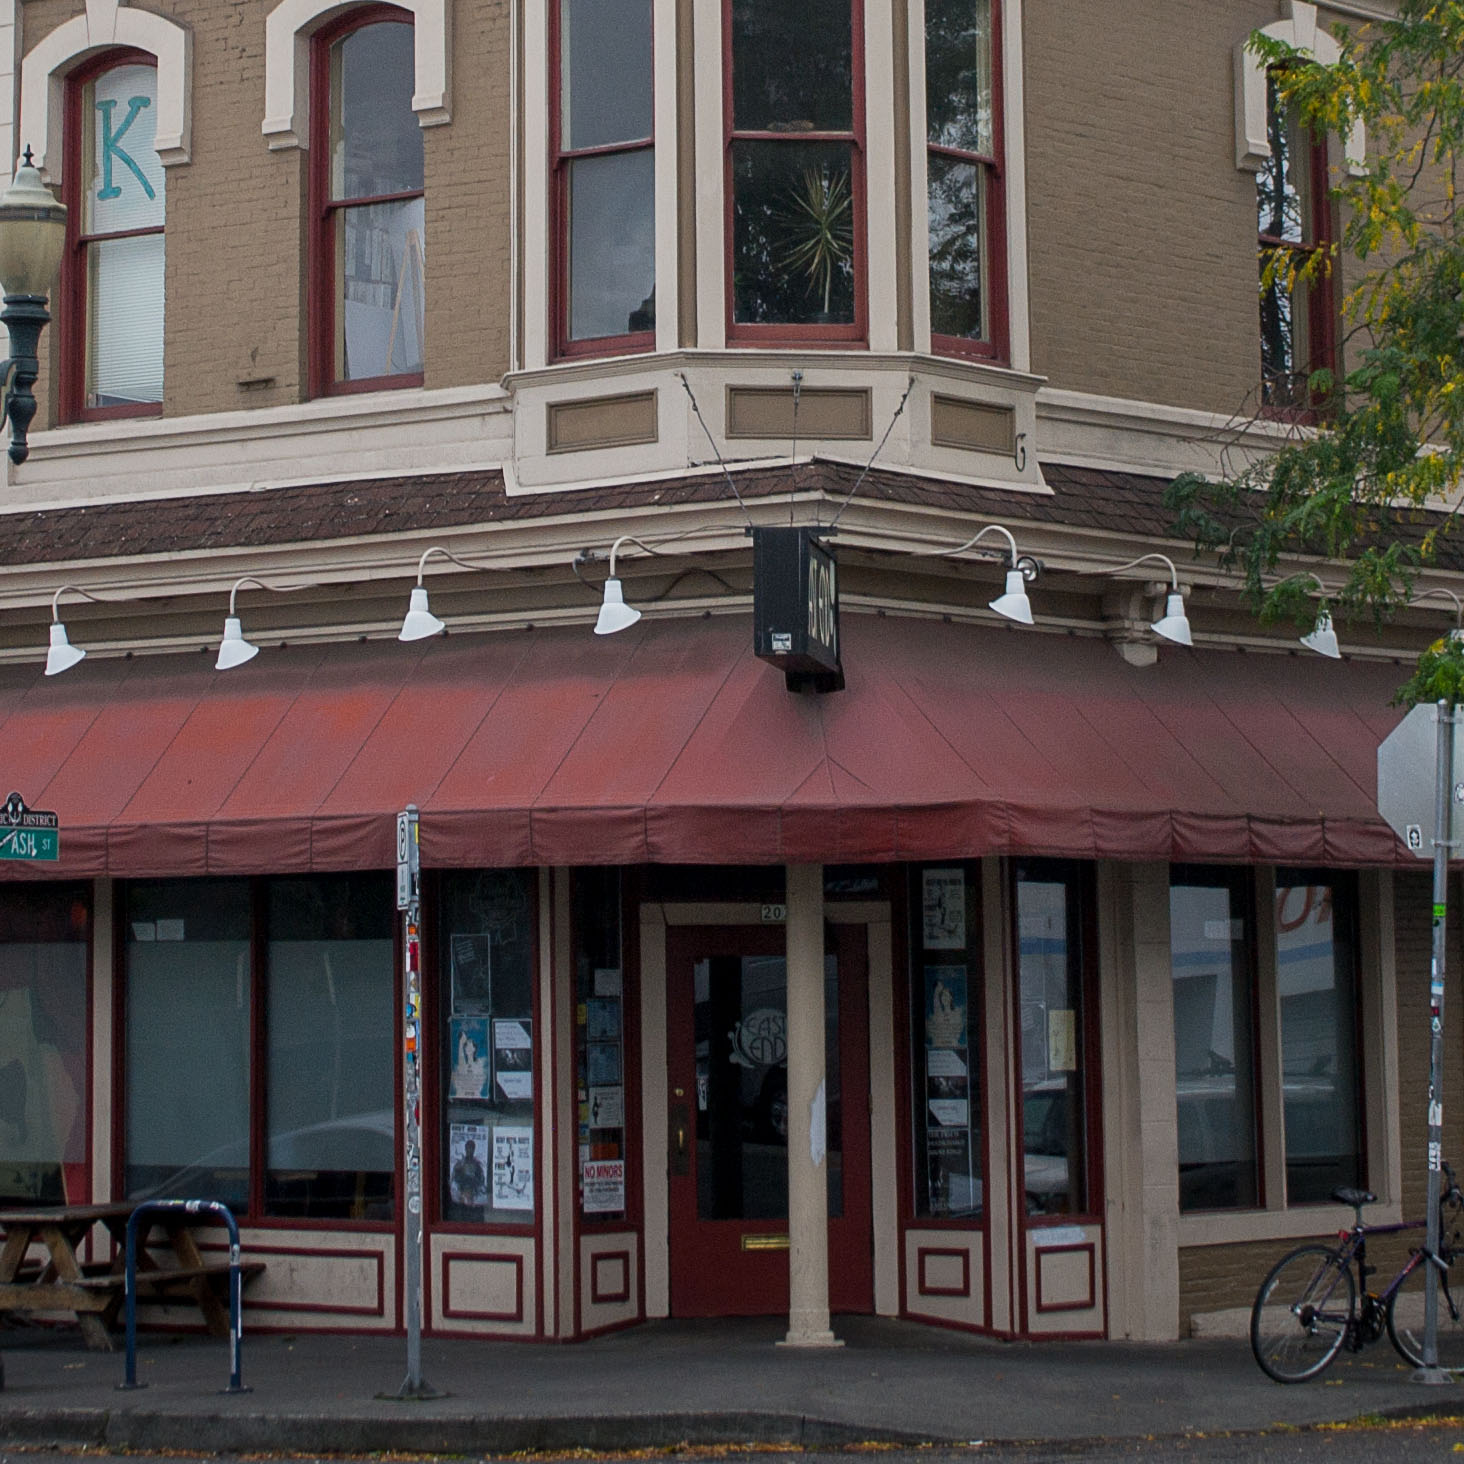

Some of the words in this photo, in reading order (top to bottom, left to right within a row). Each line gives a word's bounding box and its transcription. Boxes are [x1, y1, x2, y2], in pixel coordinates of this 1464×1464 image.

[23, 815, 57, 827] DISTRICT
[11, 831, 35, 855] ASH
[42, 839, 51, 850] ST
[748, 1036, 787, 1063] END
[584, 1165, 595, 1179] NO
[596, 1164, 623, 1179] MINORS
